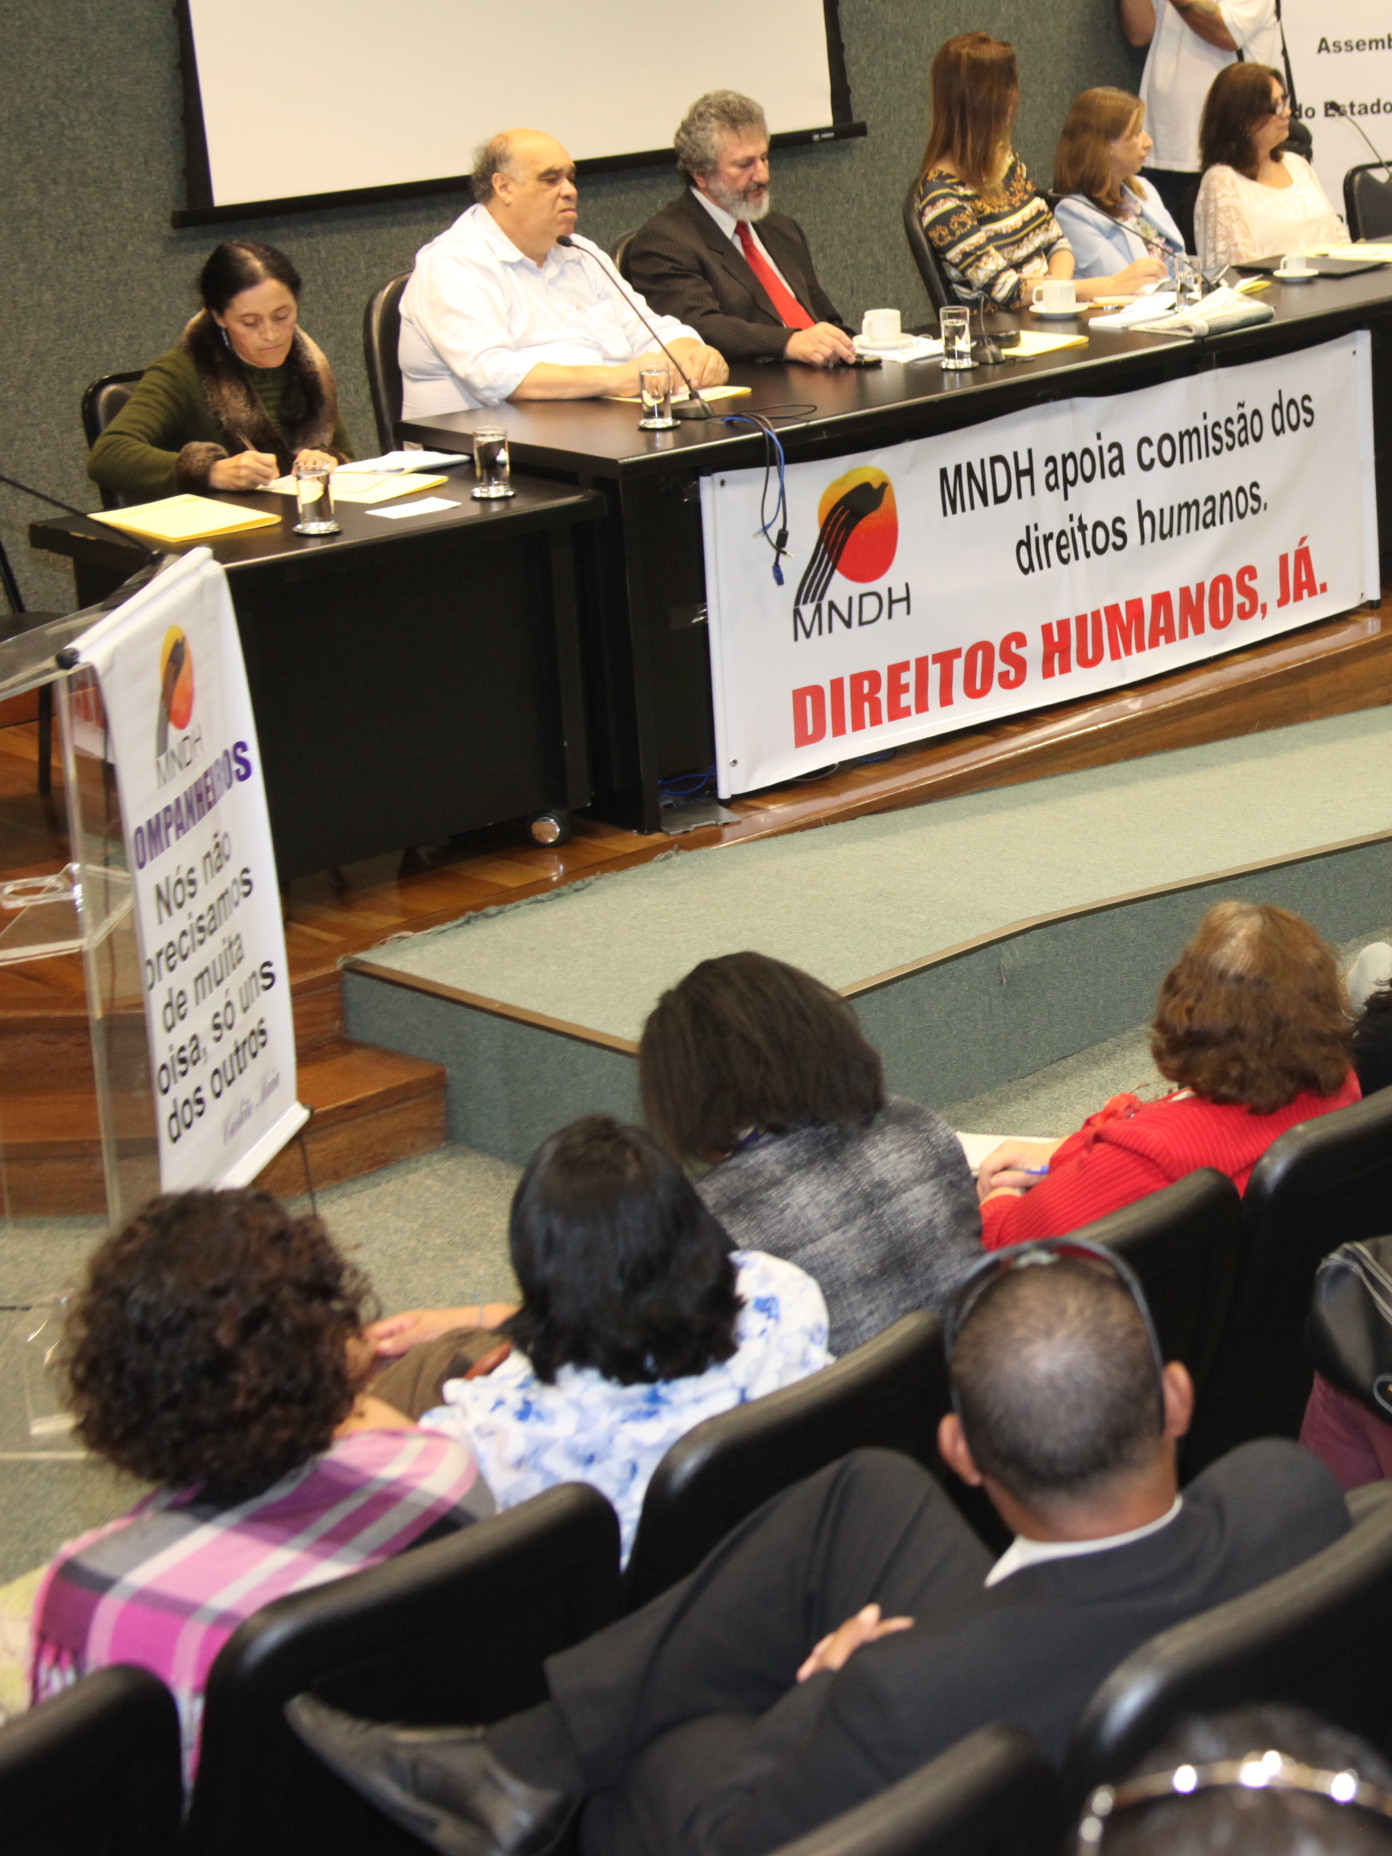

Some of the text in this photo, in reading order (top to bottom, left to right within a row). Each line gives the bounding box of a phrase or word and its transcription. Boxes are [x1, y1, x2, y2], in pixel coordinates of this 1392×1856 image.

[939, 388, 1316, 518] MNDH apoia comissão dos
[1015, 480, 1269, 576] direitos humanos.
[792, 535, 1329, 749] DIREITOS HUMANOS, JÁ.
[793, 583, 911, 642] MNDH
[133, 740, 253, 871] OMPANHEIROS
[156, 724, 205, 790] MNDH
[155, 830, 232, 926] Nós não
[157, 960, 276, 1096] oisa, só uns
[161, 932, 245, 1034] de muita
[167, 1086, 206, 1144] dos
[210, 1017, 268, 1100] outros
